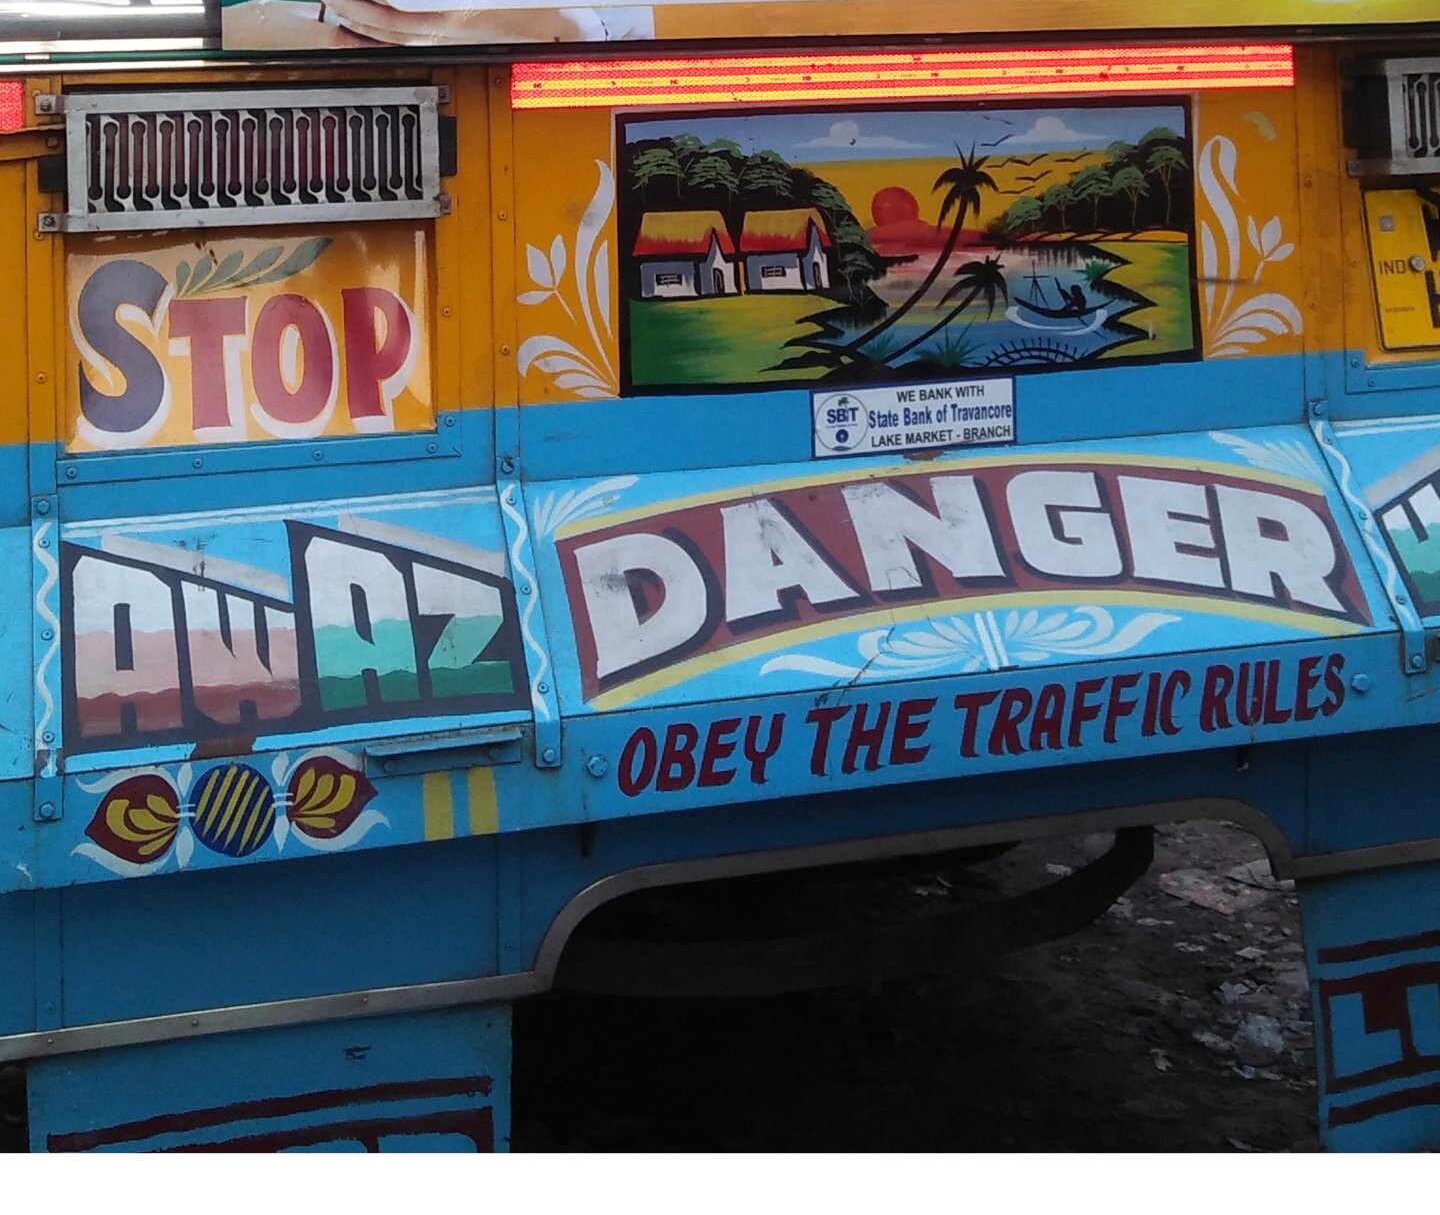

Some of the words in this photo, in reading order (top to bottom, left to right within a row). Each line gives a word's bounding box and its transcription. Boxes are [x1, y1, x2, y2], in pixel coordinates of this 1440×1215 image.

[77, 258, 416, 437] STOP
[826, 407, 859, 424] SBT
[868, 409, 899, 429] State
[903, 407, 932, 426] Bank
[936, 404, 948, 423] of
[950, 403, 1012, 423] Travancore
[896, 390, 916, 403] WE
[919, 387, 953, 402] BANK
[955, 385, 986, 399] WITH
[871, 433, 903, 449] LAKE
[904, 429, 953, 446] MARKET
[963, 425, 1011, 441] BRANCH
[571, 469, 1351, 681] DANGER
[71, 535, 517, 740] AWAZ
[616, 711, 782, 797] OBEY
[807, 696, 942, 777] THE
[951, 667, 1193, 760] TRAFFIC
[1196, 652, 1349, 734] RULES
